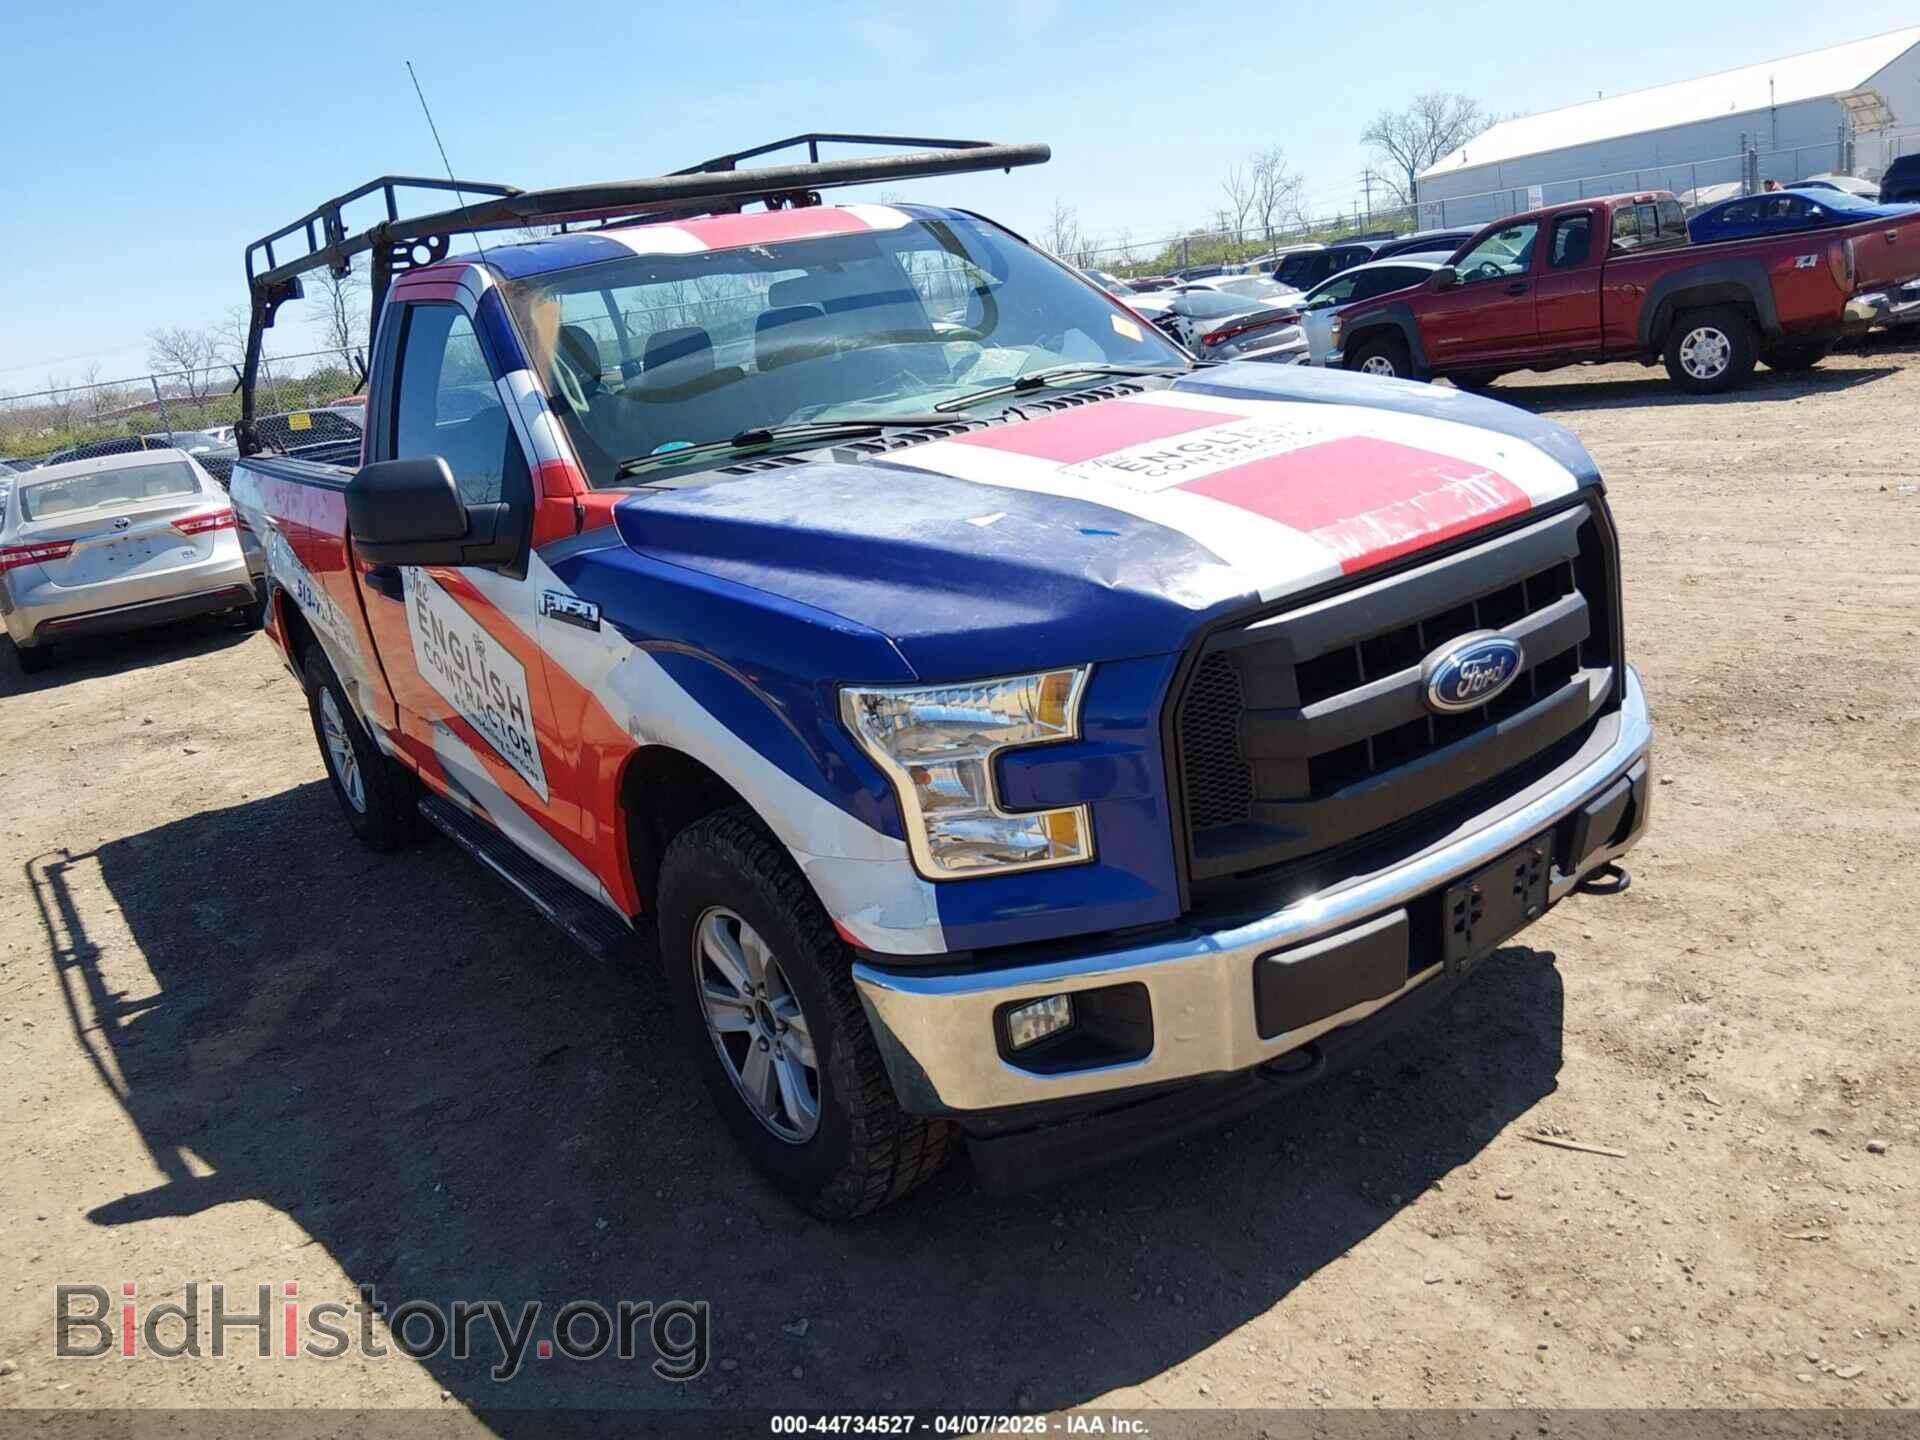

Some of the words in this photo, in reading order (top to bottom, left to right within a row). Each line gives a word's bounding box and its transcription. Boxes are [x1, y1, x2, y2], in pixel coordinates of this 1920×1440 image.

[1112, 422, 1293, 472] ENGLI
[1145, 426, 1322, 477] CONTRACT
[416, 597, 527, 732] ENGLISH
[1457, 653, 1505, 698] Ford
[423, 641, 535, 763] CONTRACTOR
